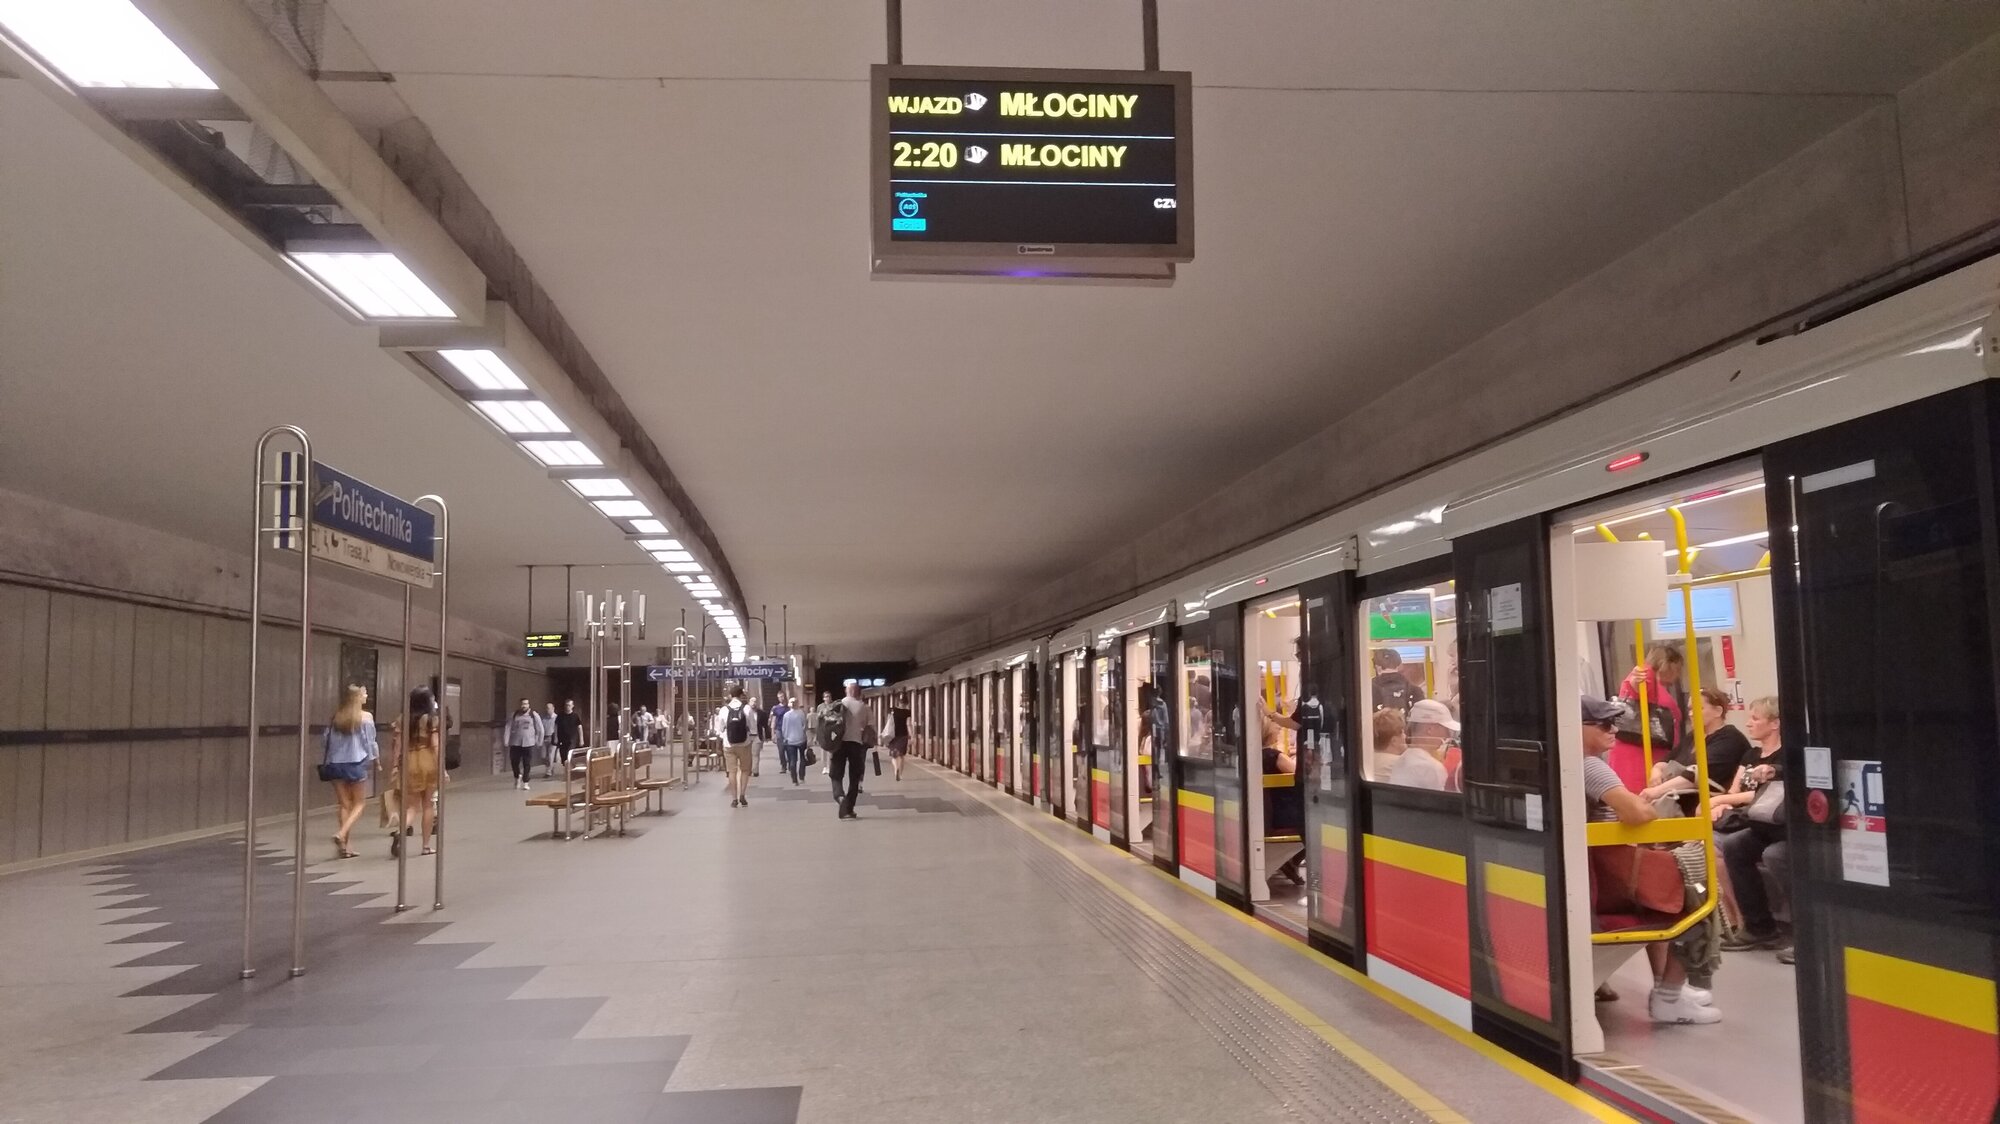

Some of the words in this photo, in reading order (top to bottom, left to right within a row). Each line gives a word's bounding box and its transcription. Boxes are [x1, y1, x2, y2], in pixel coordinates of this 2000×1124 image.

[888, 96, 963, 115] WJAZD
[1000, 92, 1139, 118] MŁOCINY
[893, 141, 958, 168] 2:20
[1000, 143, 1128, 168] MŁOCINY
[332, 480, 413, 544] Politechnika
[733, 666, 775, 677] Młociny
